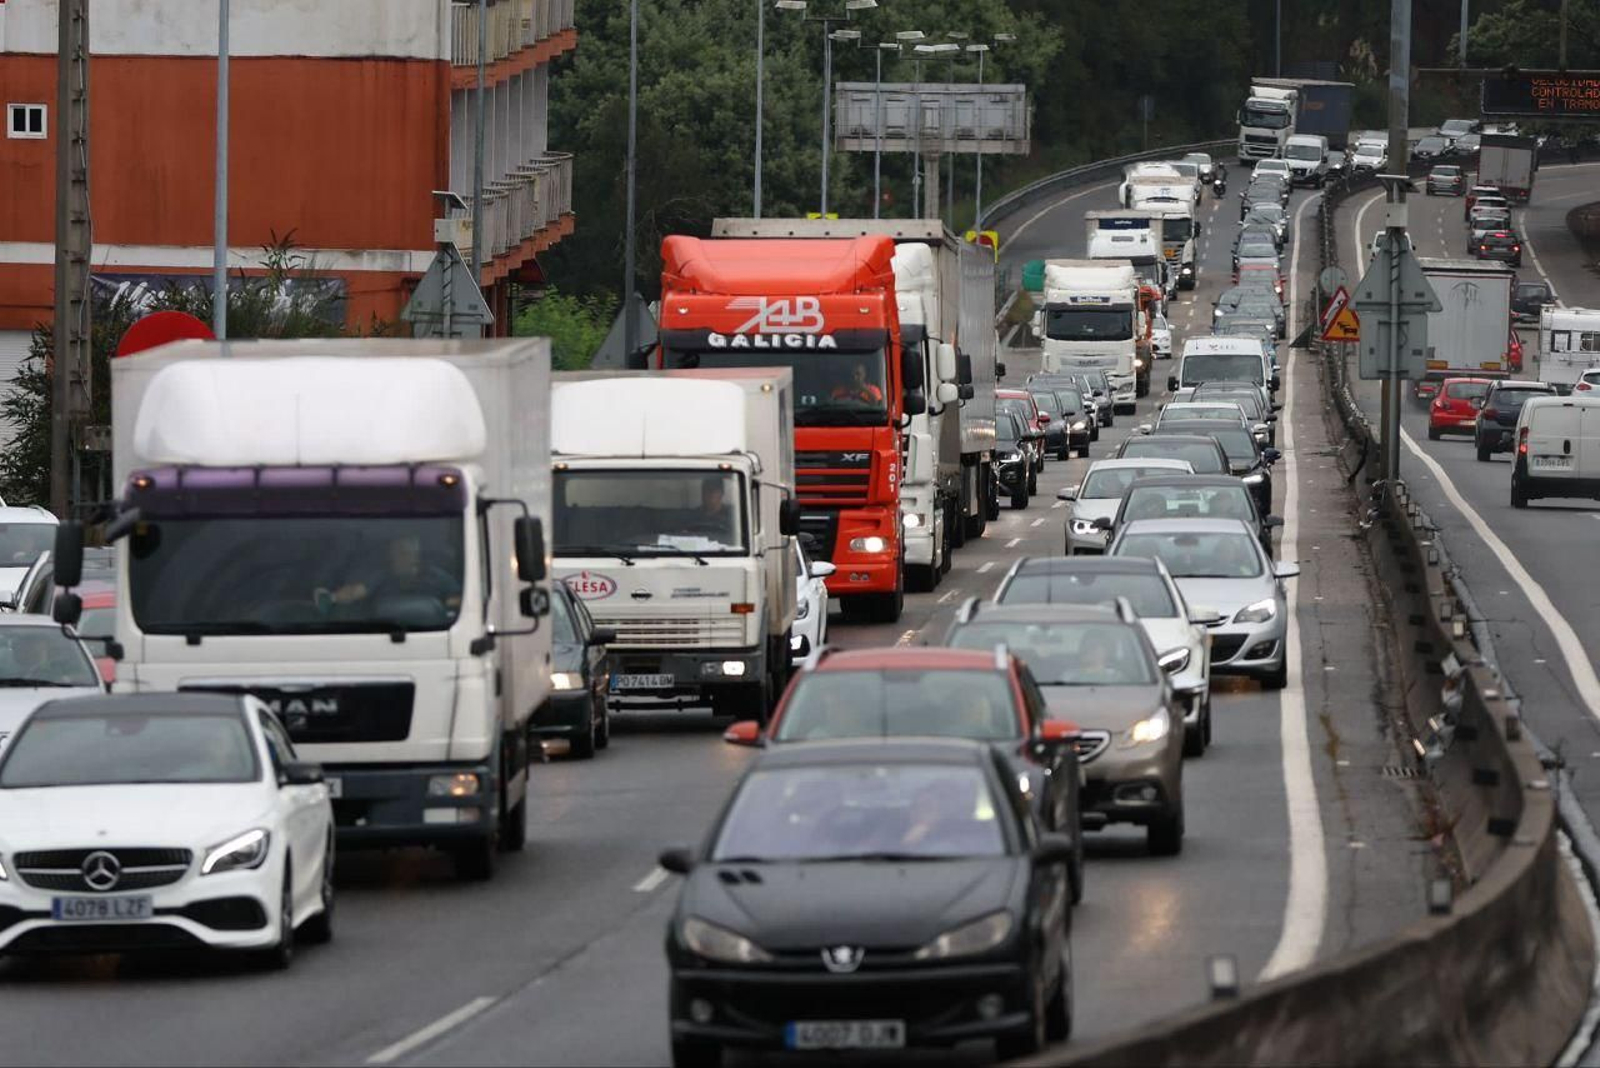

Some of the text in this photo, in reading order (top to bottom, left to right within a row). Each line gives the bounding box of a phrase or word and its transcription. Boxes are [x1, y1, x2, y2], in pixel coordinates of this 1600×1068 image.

[1539, 98, 1555, 109] EN
[708, 332, 838, 348] GALICIA
[840, 453, 870, 462] XF
[889, 463, 897, 493] 201
